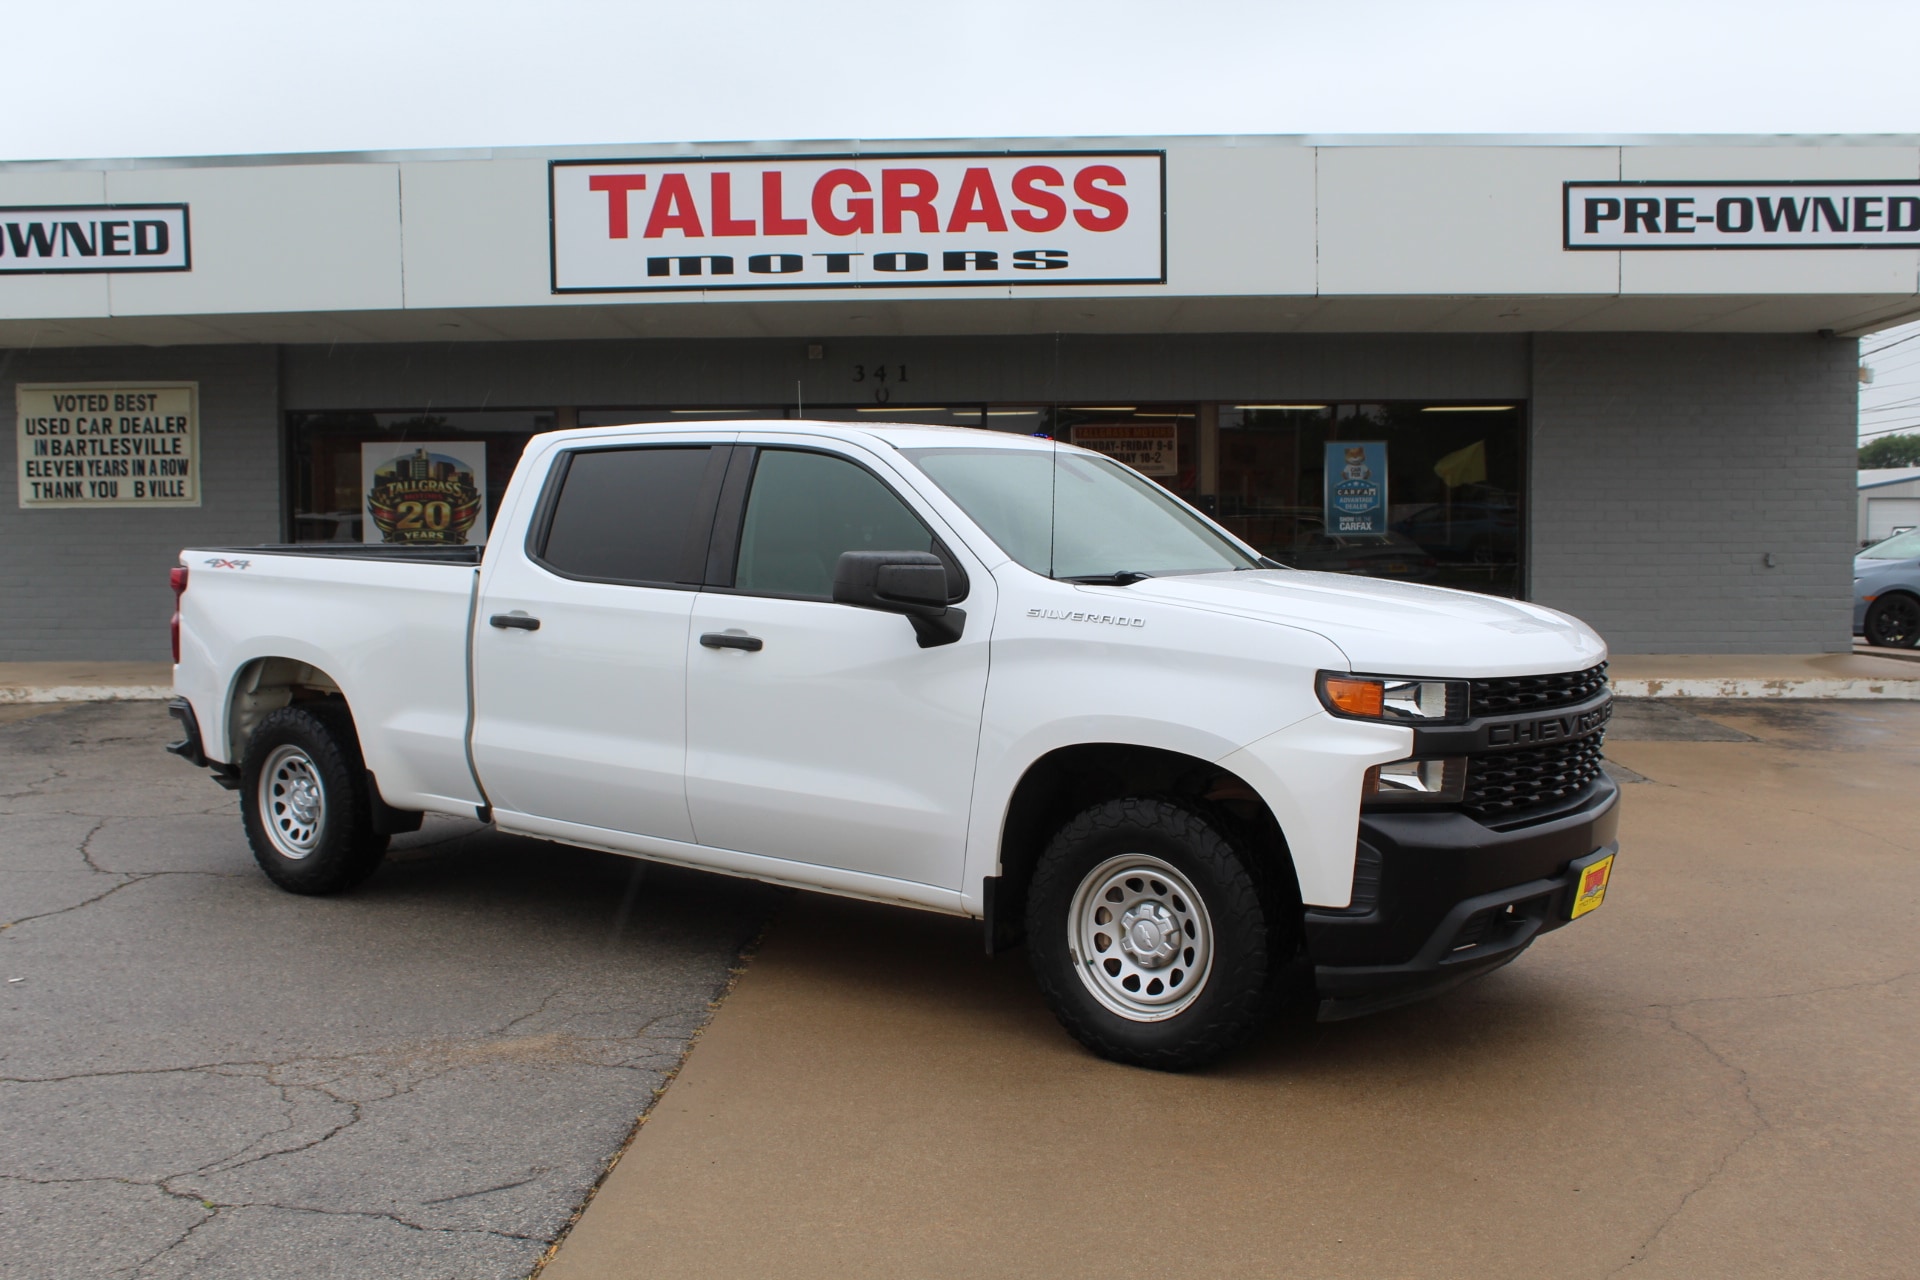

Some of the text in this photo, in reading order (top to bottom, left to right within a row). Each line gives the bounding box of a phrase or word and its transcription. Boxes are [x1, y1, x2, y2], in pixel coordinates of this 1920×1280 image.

[589, 165, 1129, 239] TALLGRASS
[1584, 196, 1920, 233] PRE-OWNED
[0, 220, 169, 258] WNED
[647, 250, 1069, 276] MOTORS
[852, 364, 909, 383] 341
[53, 394, 157, 412] VOTED BEST
[26, 416, 187, 435] USED CAR DEALER
[34, 438, 182, 456] IN BARTLESVILLE
[26, 459, 189, 477] ELEVEN YEARS IN A ROW
[31, 481, 83, 499] THANK
[89, 481, 118, 498] YOU
[386, 480, 462, 498] TALLGRASS
[396, 501, 451, 530] 20
[404, 531, 445, 539] YEARS
[1339, 522, 1372, 531] CARFAX
[1026, 608, 1145, 628] SILVERADO
[1488, 700, 1613, 747] CHEVROLE
